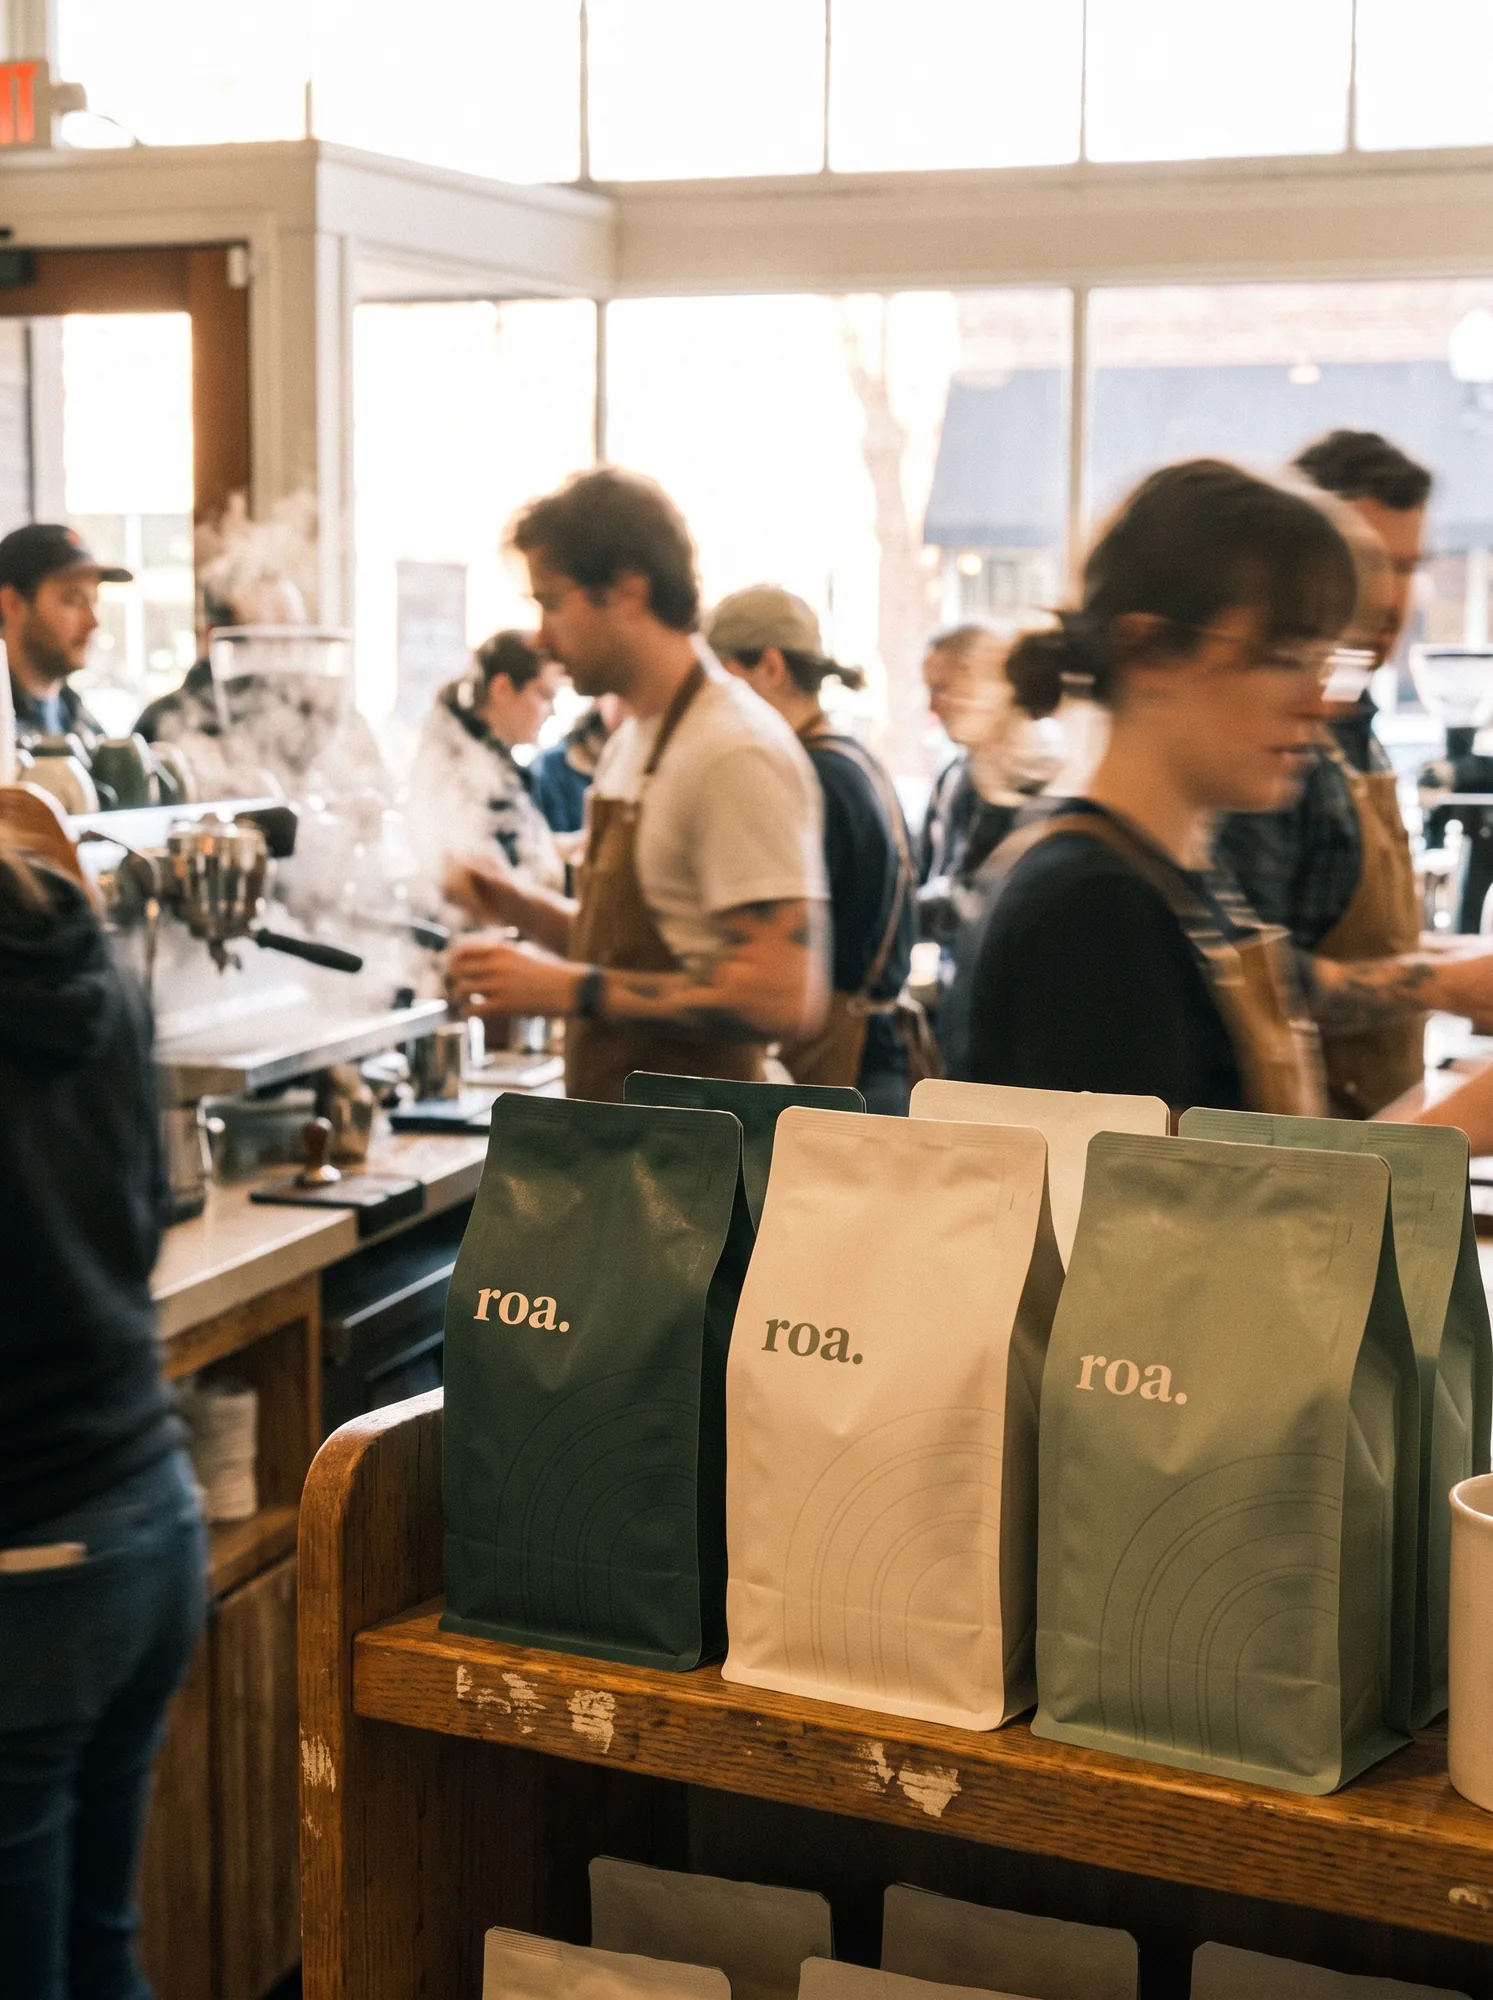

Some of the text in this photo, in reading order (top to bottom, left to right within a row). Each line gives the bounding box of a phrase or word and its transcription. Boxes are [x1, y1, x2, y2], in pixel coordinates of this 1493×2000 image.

[473, 1288, 570, 1333] roa.
[761, 1319, 863, 1365] roa.
[1075, 1354, 1188, 1405] roa.
